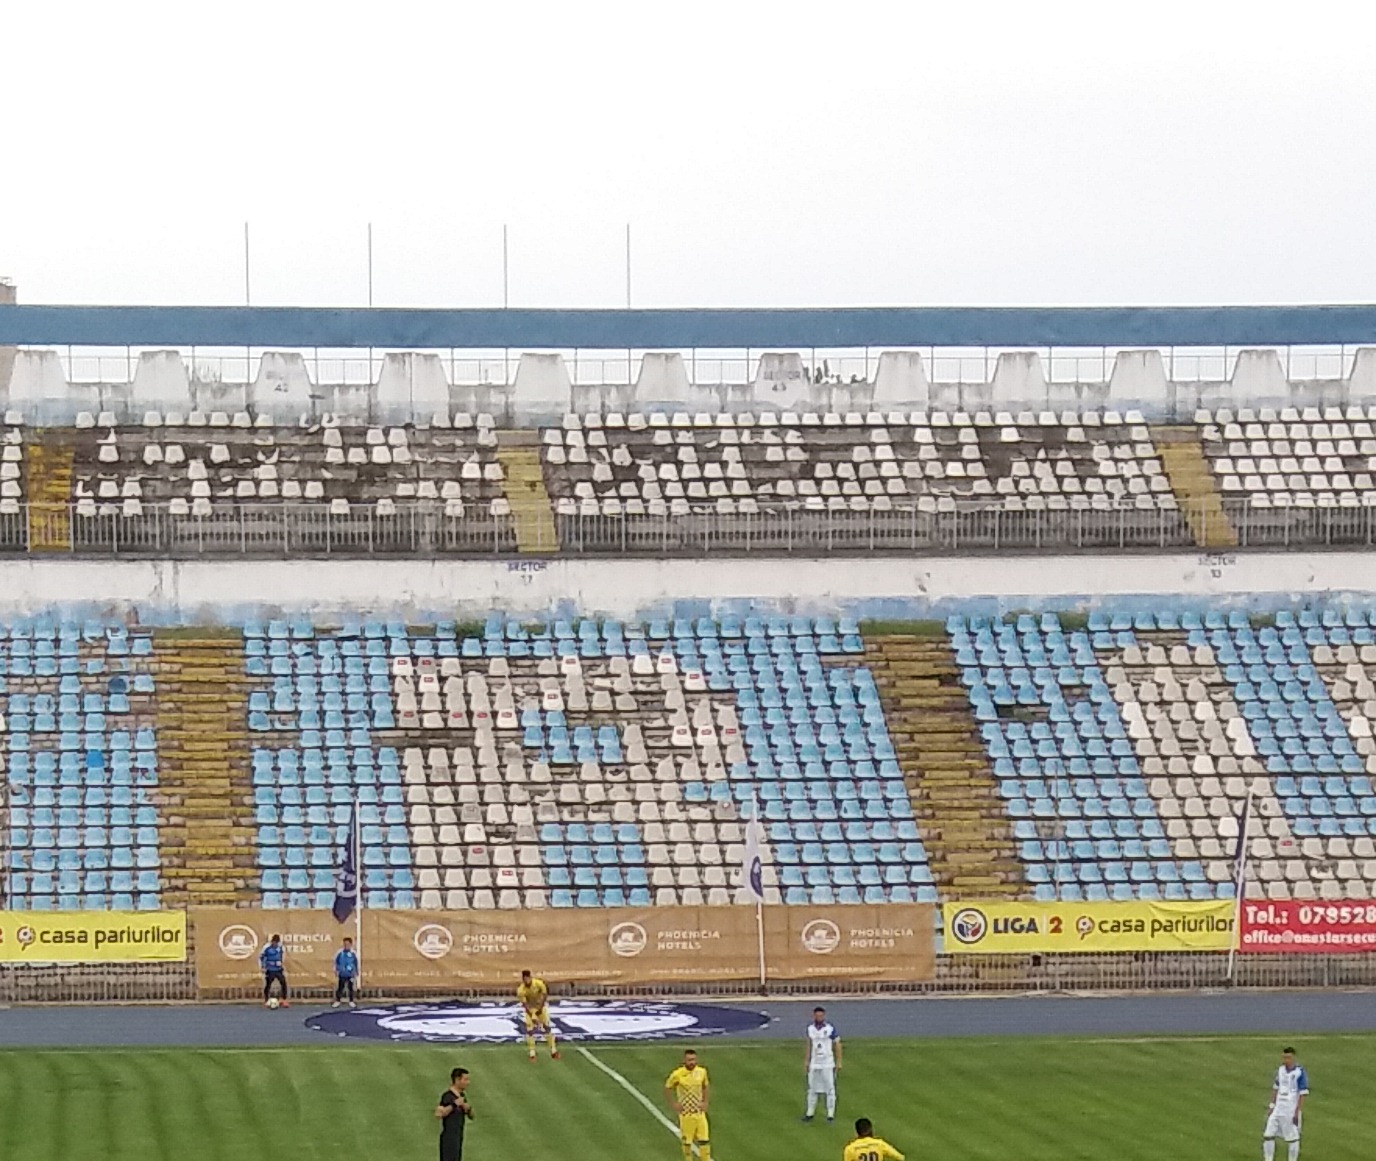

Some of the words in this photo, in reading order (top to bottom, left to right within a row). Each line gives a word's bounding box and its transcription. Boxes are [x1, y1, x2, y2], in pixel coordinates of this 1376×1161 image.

[1246, 905, 1288, 924] Tel.:
[993, 917, 1039, 933] LIGA
[1049, 916, 1062, 935] 2
[1098, 917, 1144, 933] casa
[1150, 915, 1234, 938] pariurilor
[658, 930, 720, 939] PHOENICIA
[850, 928, 913, 937] PHOENICIA
[40, 928, 88, 944] casa
[94, 926, 181, 949] pariurilor
[464, 934, 526, 942] PHOENICIA
[658, 941, 701, 949] HOTELS
[850, 939, 894, 947] HOTELS
[464, 944, 508, 952] HOTELS
